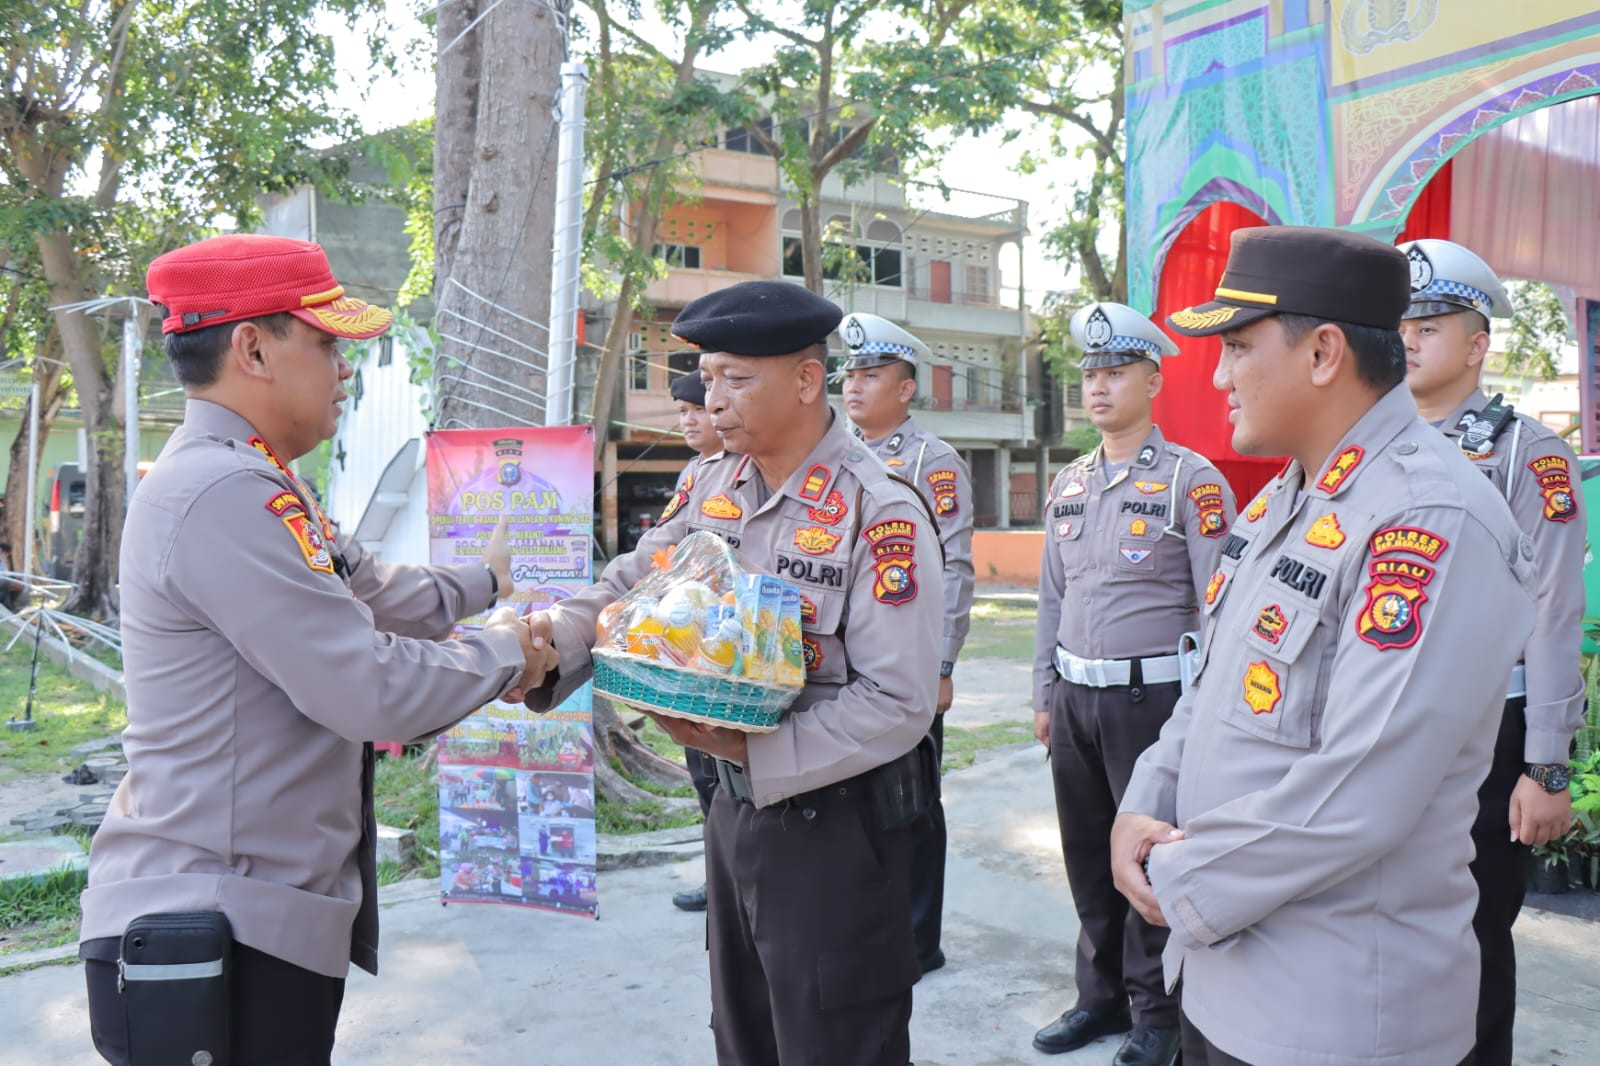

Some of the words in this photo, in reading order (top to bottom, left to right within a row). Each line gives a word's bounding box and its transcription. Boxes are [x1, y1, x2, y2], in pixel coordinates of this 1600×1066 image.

[1543, 475, 1568, 484] RIAU
[461, 491, 505, 511] POS
[510, 490, 557, 510] PAM
[1199, 499, 1222, 507] RIAU
[1121, 501, 1166, 518] POLRI
[868, 522, 912, 538] POLRES
[1374, 530, 1441, 549] POLRES
[876, 545, 911, 555] RIAU
[512, 565, 576, 583] Pelayanan
[776, 555, 844, 588] POLRI
[1270, 555, 1328, 600] POLRI
[1376, 562, 1426, 577] RIAU
